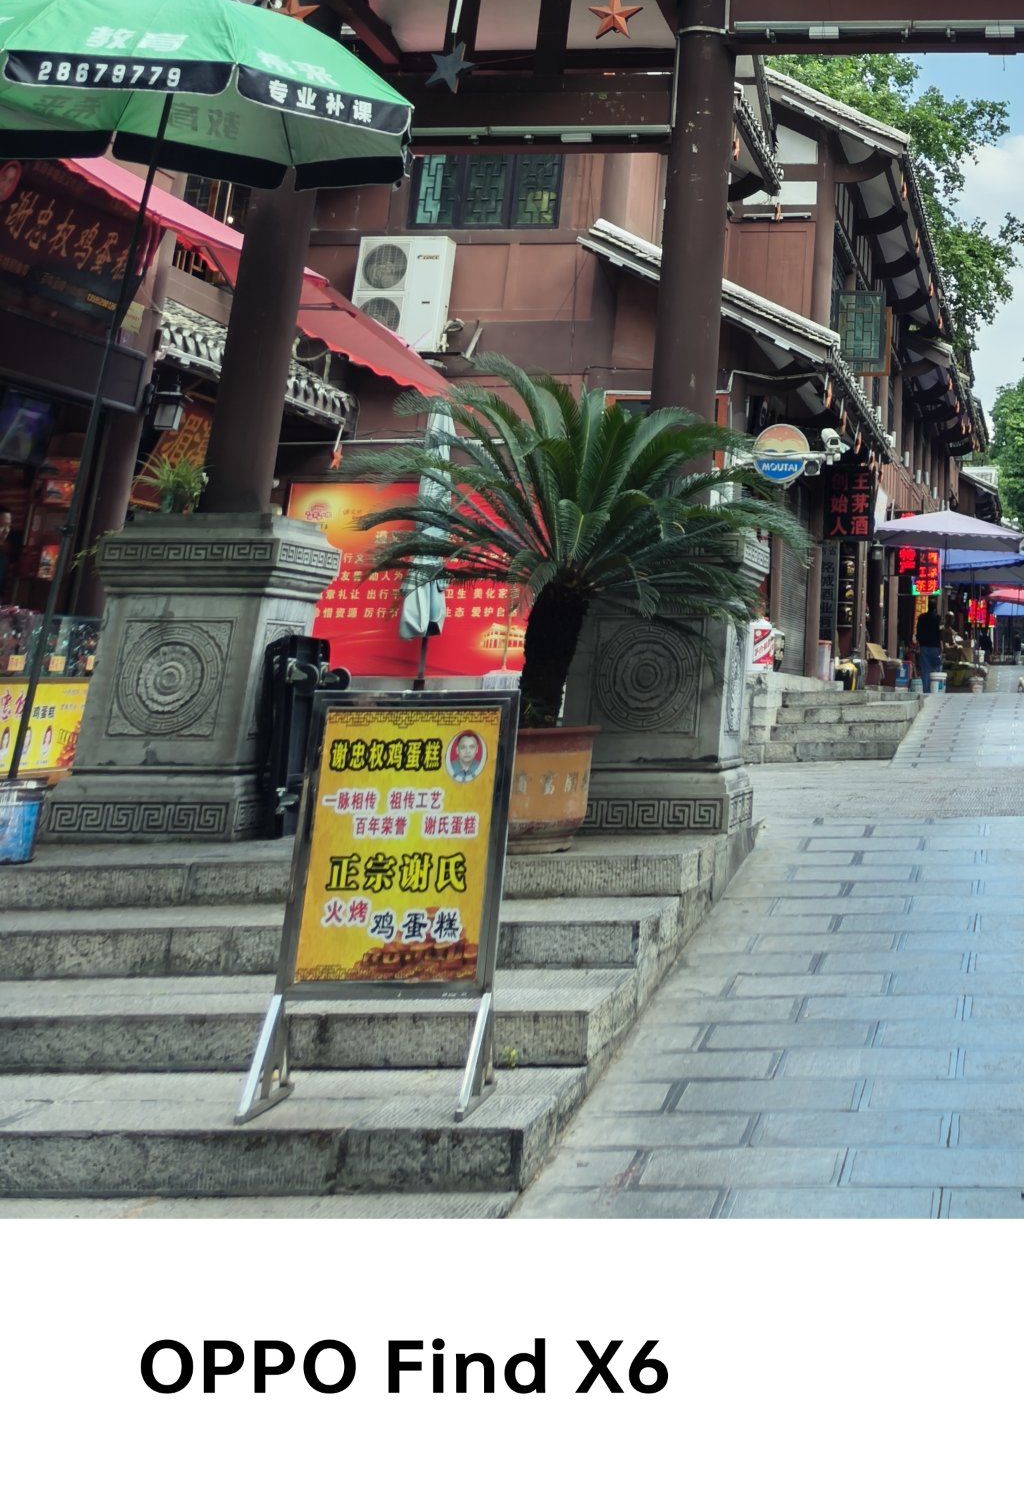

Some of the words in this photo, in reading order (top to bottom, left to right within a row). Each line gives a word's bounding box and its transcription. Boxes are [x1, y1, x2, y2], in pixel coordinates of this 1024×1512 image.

[86, 25, 188, 52] 教育
[38, 61, 182, 87] 28679779
[268, 79, 373, 124] 专业补课
[761, 462, 798, 473] MOUTAI
[850, 473, 870, 537] 王茅酒
[320, 588, 360, 600] 章礼让
[330, 739, 442, 772] 谢忠权鸡蛋糕
[324, 791, 377, 810] 一脉相传
[389, 790, 442, 810] 祖传工艺
[355, 816, 408, 836] 百年荣誉
[423, 815, 478, 835] 谢氏蛋糕
[325, 851, 468, 893] 正宗谢氏
[324, 899, 369, 924] 火烤
[370, 910, 461, 939] 鸡蛋糕
